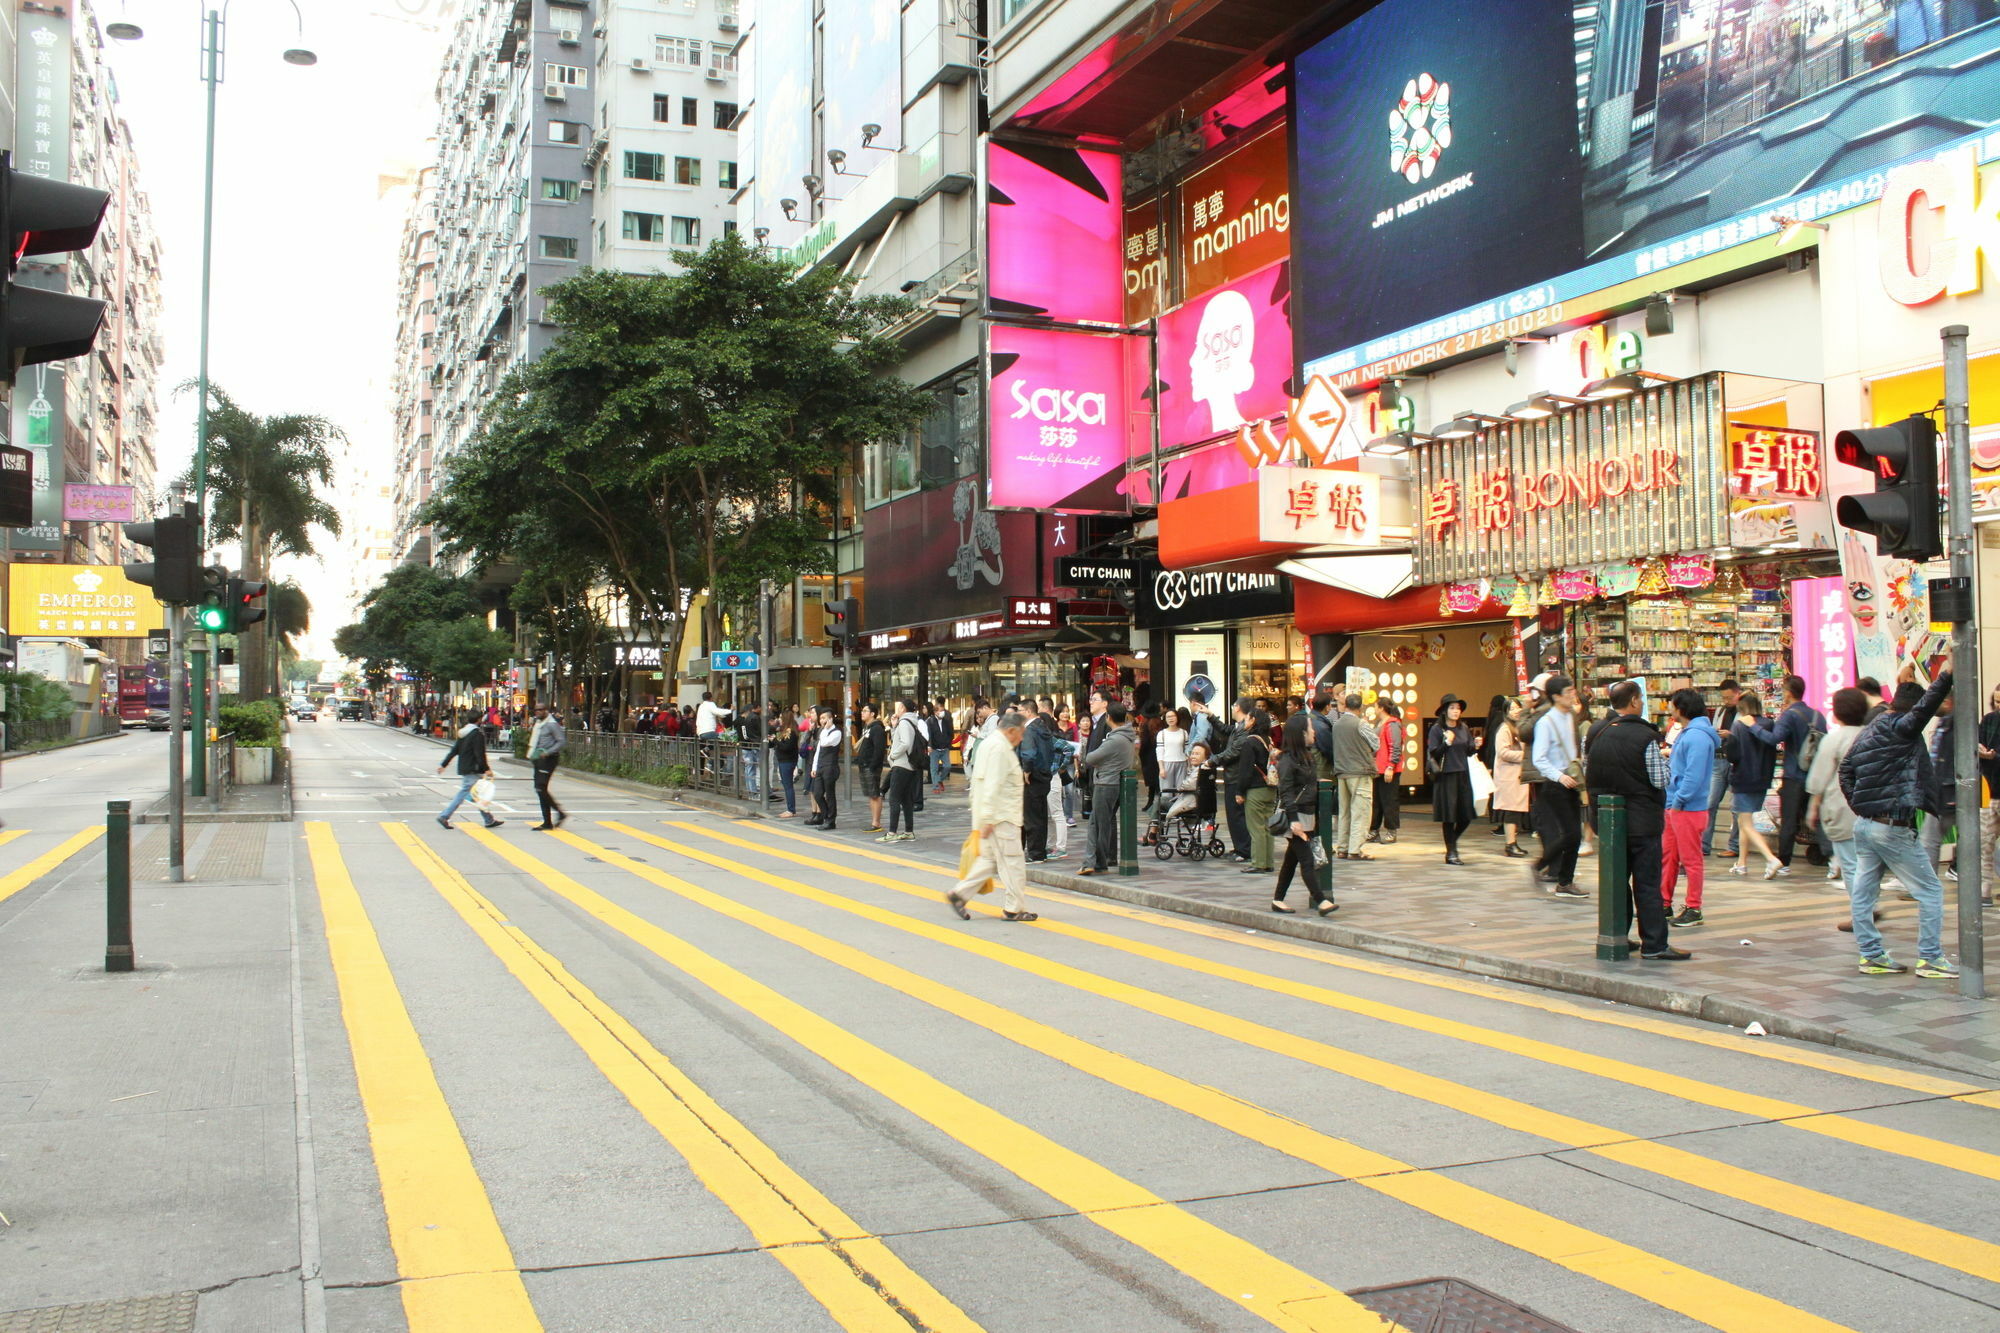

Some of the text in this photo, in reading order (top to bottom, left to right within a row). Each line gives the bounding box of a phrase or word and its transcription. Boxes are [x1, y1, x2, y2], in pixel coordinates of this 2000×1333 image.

[1372, 172, 1474, 229] JM NETWORK
[1193, 190, 1225, 232] 萬寧
[1336, 370, 1358, 390] JM
[1361, 341, 1449, 381] NETWORK
[1455, 303, 1563, 353] 27230020
[1039, 425, 1078, 448] 莎莎
[1016, 452, 1101, 467] making life beautiful
[1521, 446, 1682, 513] BONJOUR
[1070, 566, 1132, 580] CITY CHAIN
[1190, 572, 1223, 598] CITY
[1226, 572, 1276, 593] CHAIN
[39, 594, 136, 607] EMPEROR
[1015, 601, 1052, 614] 周大福
[955, 620, 979, 638] 周大福
[870, 634, 889, 649] 周大福
[1246, 641, 1280, 649] SUUNTO
